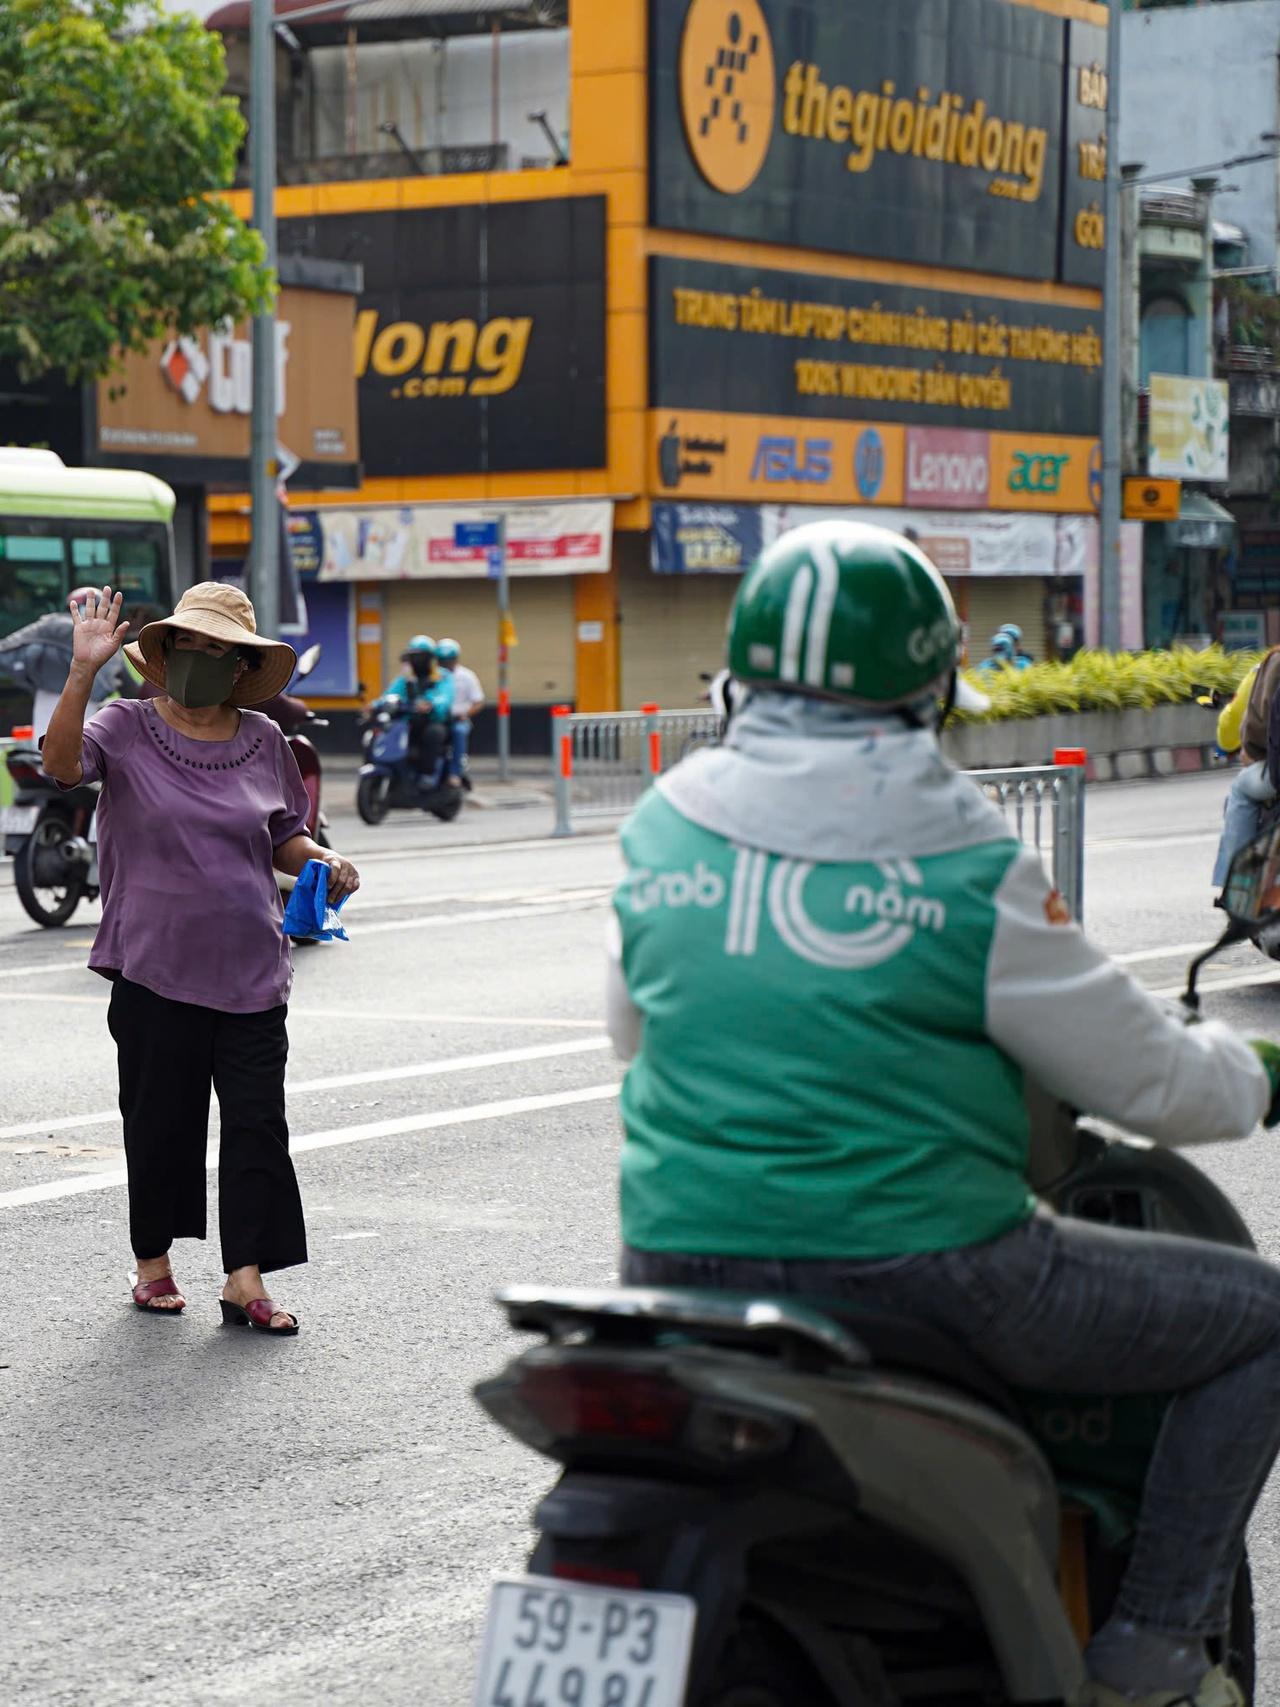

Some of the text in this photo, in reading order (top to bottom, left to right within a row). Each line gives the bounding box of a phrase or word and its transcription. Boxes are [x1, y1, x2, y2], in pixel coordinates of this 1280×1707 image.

[782, 60, 1048, 202] thegioididong
[750, 435, 833, 484] ASUS
[908, 442, 988, 494] Lenovo
[1008, 449, 1071, 493] acer
[513, 1590, 659, 1664] 59-P3
